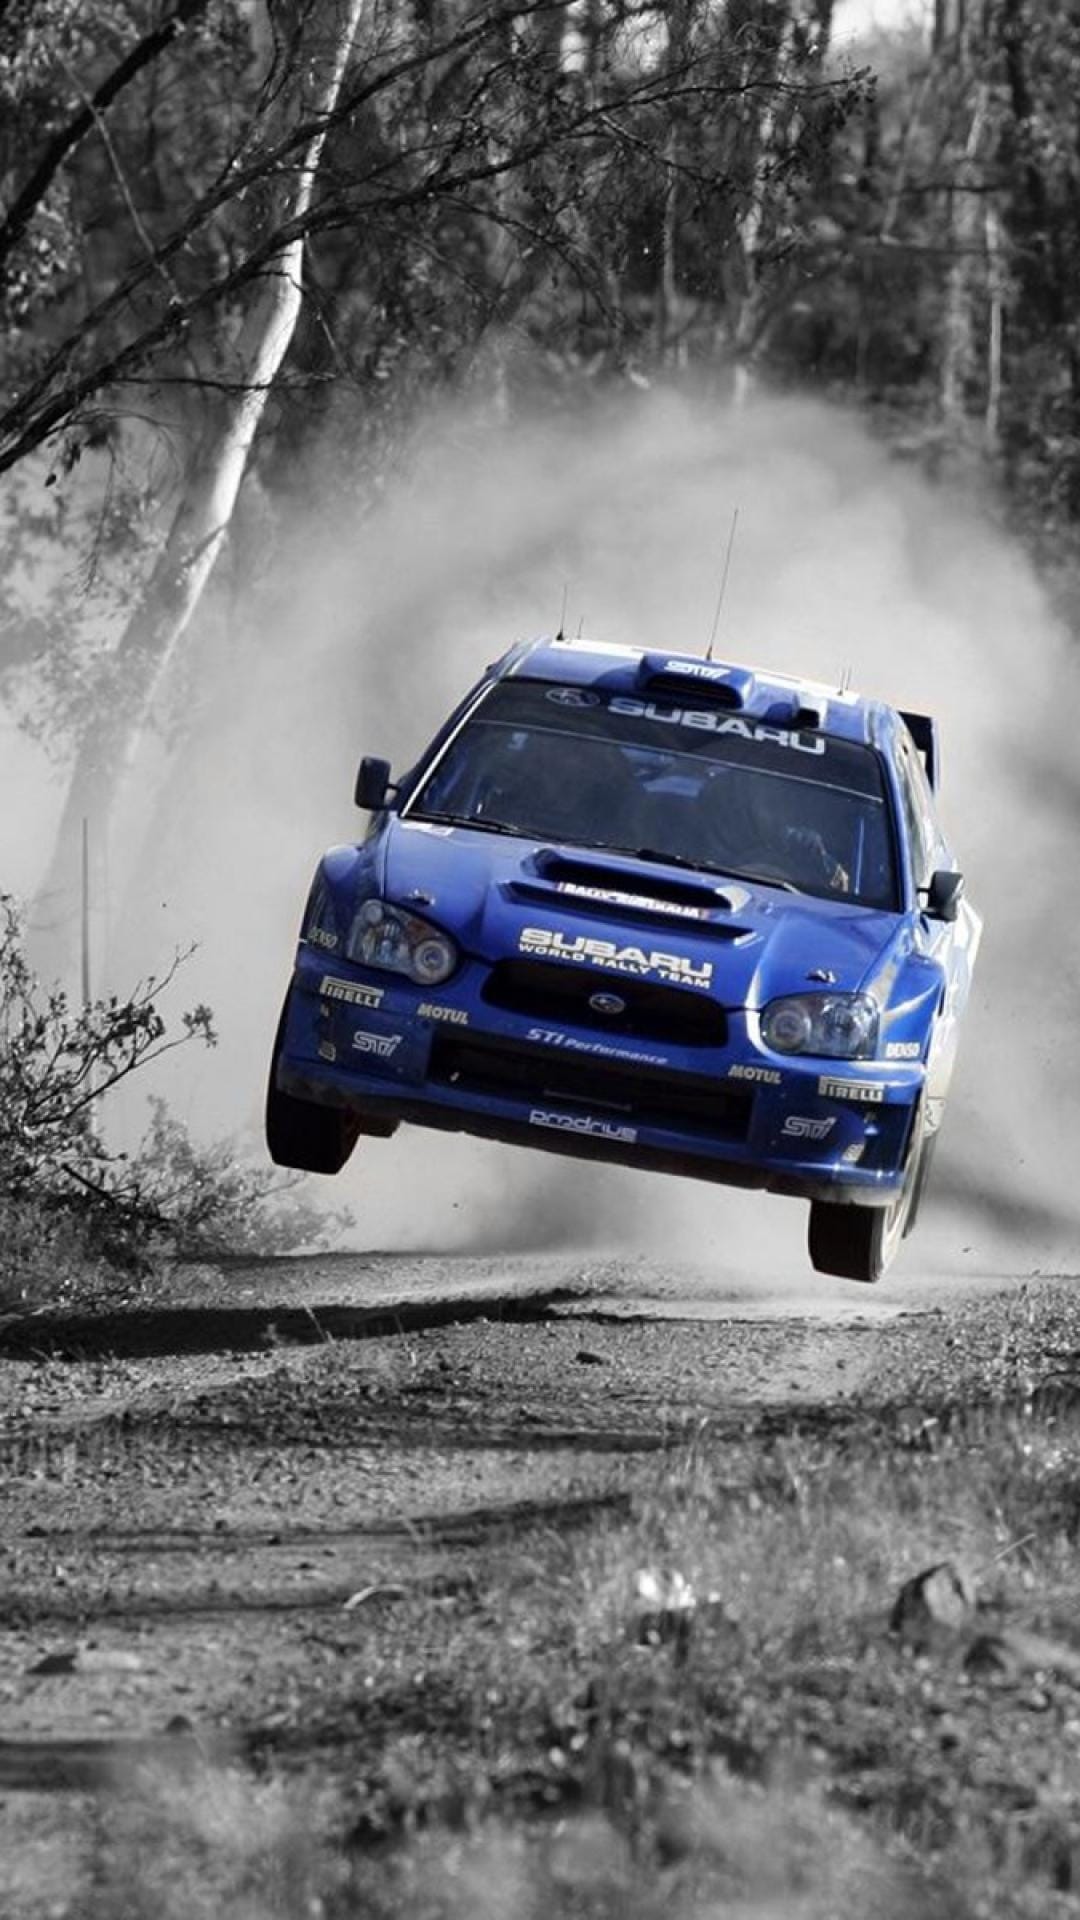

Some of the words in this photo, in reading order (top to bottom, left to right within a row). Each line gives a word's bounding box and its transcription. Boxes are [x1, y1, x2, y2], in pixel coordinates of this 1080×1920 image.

[607, 698, 825, 755] SUBARU
[518, 943, 585, 961] WORLD
[592, 955, 650, 975] RALLY
[657, 969, 711, 990] TEAM
[520, 928, 713, 978] SUBARU
[319, 975, 385, 1009] PIRELLI
[417, 1003, 469, 1025] MOTUL
[564, 1038, 669, 1065] Performance
[728, 1064, 782, 1085] MOTUL
[818, 1075, 885, 1103] PIRELLI
[529, 1109, 638, 1144] prodrive
